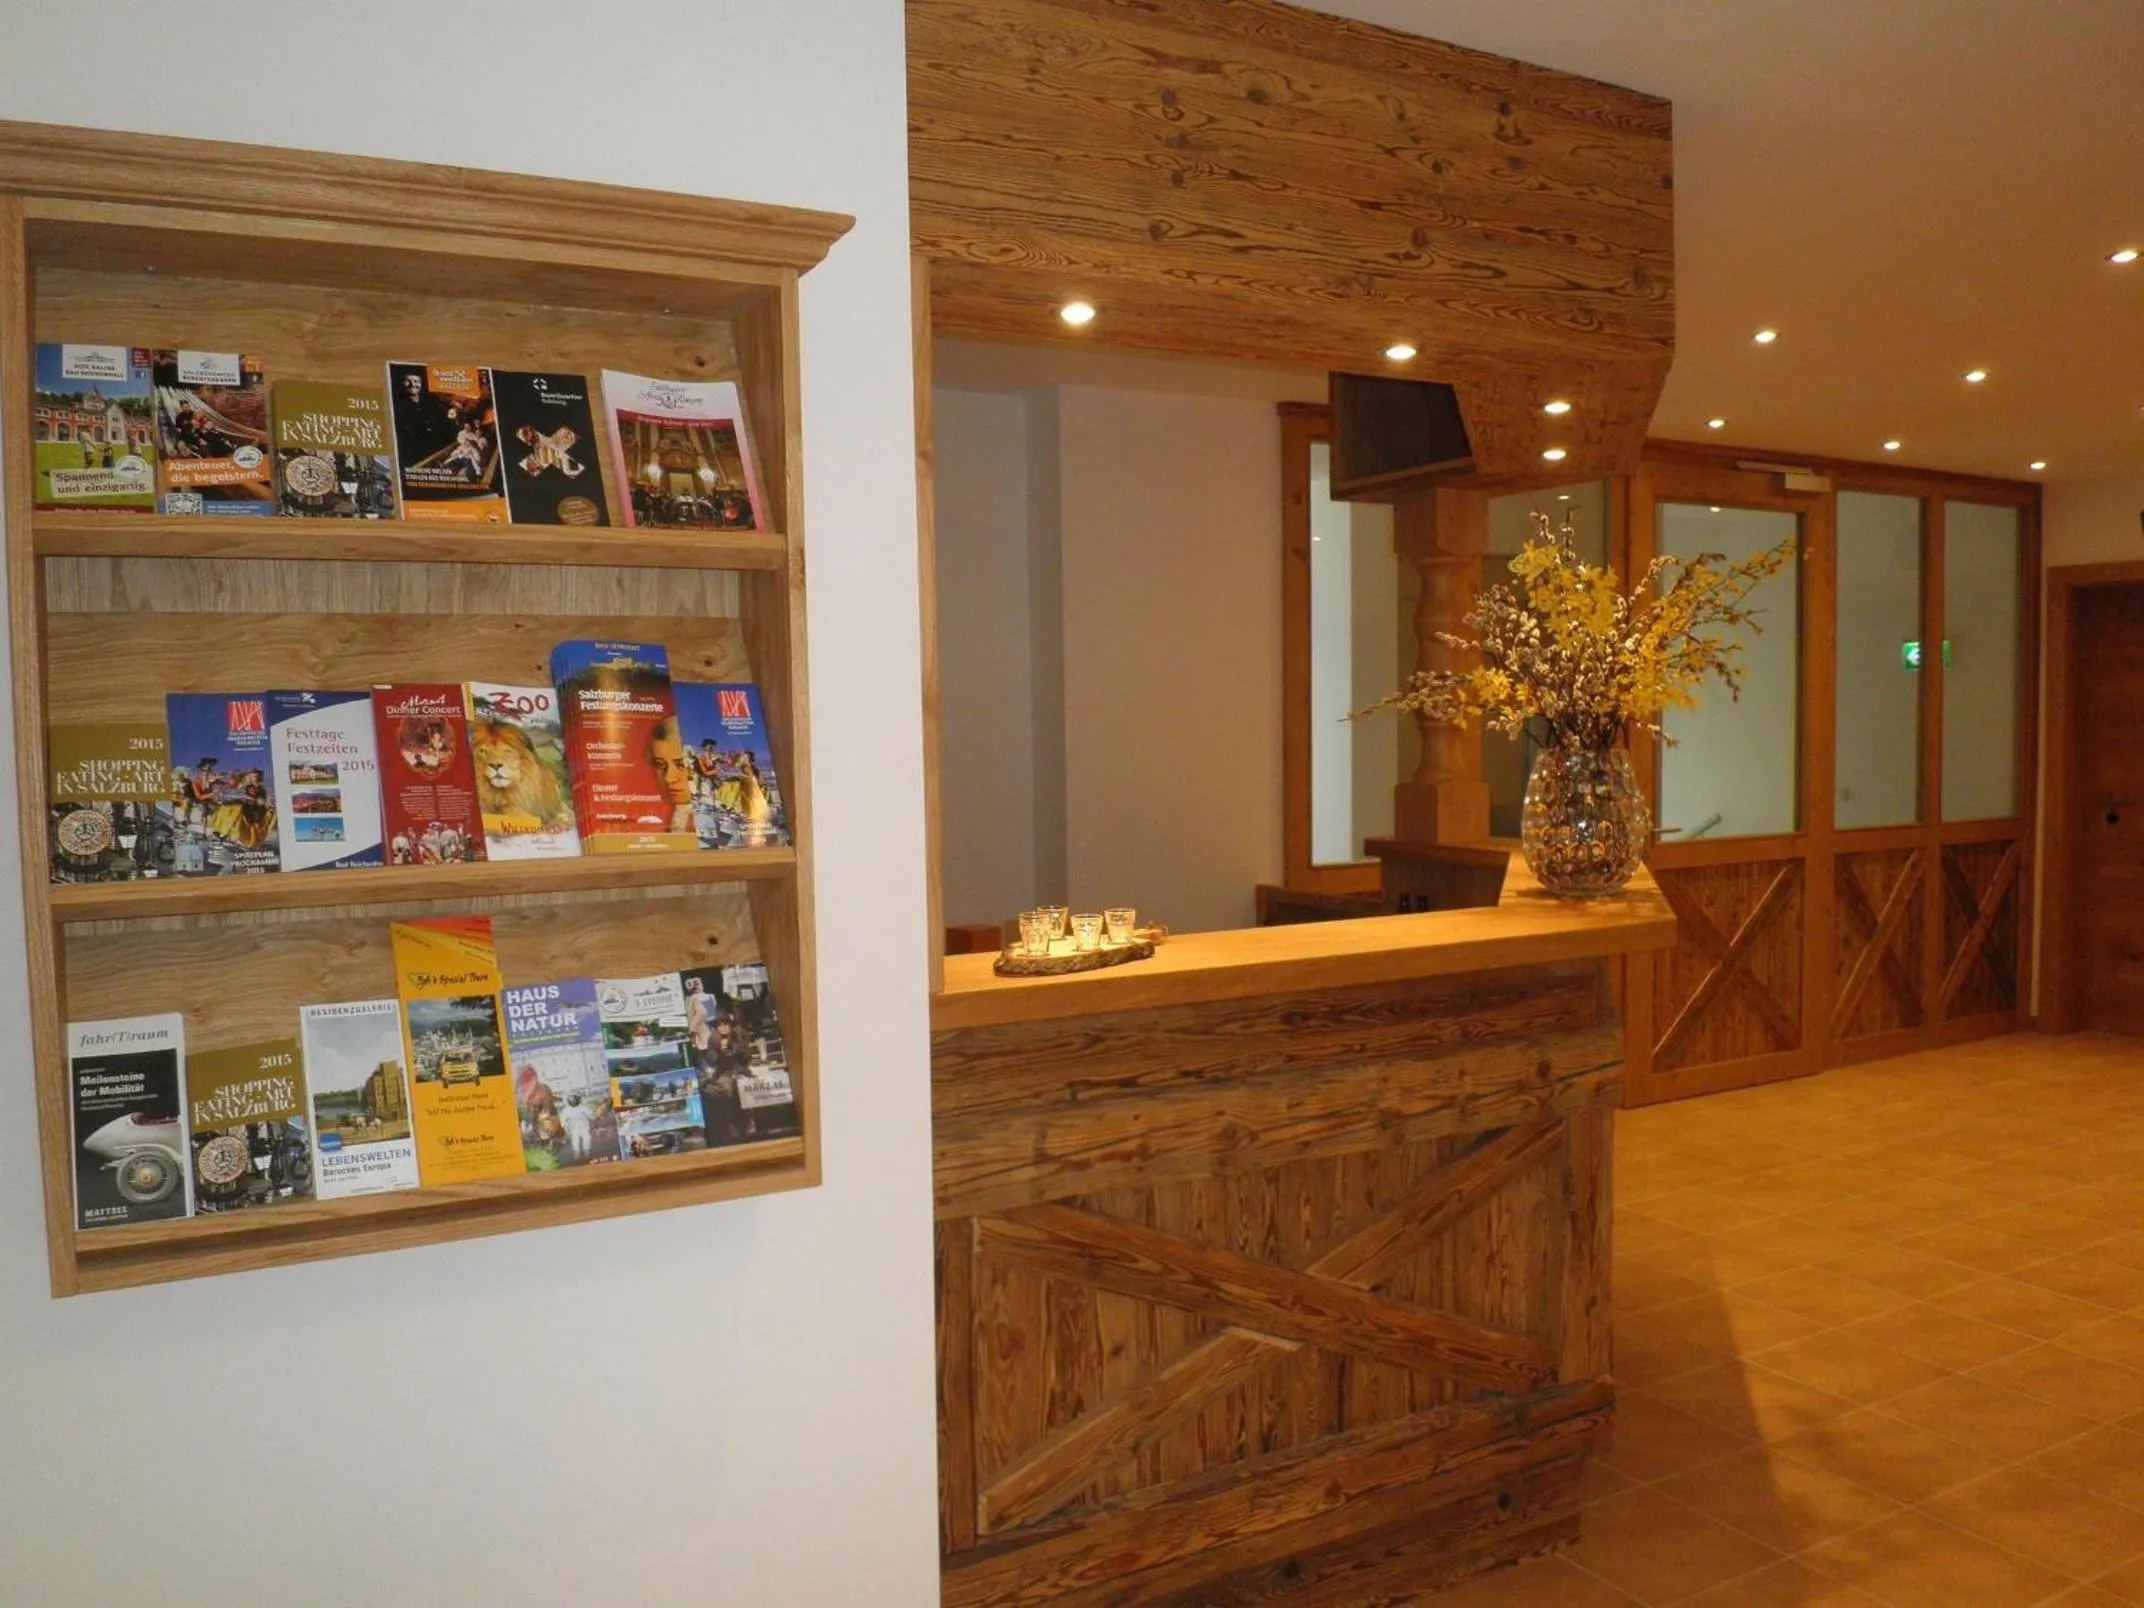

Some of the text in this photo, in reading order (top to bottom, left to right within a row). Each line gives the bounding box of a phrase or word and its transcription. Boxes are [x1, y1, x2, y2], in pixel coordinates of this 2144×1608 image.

[347, 398, 380, 411] 2015
[303, 412, 382, 432] SHOPPING
[301, 432, 383, 449] SALZBURG
[56, 471, 114, 484] Spannend
[171, 472, 191, 483] die
[58, 484, 80, 494] und
[579, 689, 631, 702] Salzburger
[386, 705, 461, 714] Dinner Concert
[580, 701, 664, 713] Festungskonzerte
[286, 728, 345, 741] Festtage
[128, 738, 164, 750] 2015
[287, 741, 358, 754] Festzeiten
[80, 759, 166, 772] SHOPPING
[342, 760, 375, 772] 2015
[57, 771, 163, 782] EATING ART
[57, 782, 166, 795] IN SALZBURG
[506, 985, 560, 1004] HAUS
[508, 1002, 548, 1018] DER
[511, 1012, 577, 1033] NATUR
[80, 1030, 169, 1048] fahr(T)raum
[259, 1054, 292, 1069] 2015
[80, 1072, 146, 1086] Meilensteine
[80, 1084, 145, 1098] der Mobilität
[215, 1076, 294, 1097] SHOPPING
[195, 1100, 297, 1125] IN SALZBURG
[322, 1148, 411, 1167] LEBENSWELTEN
